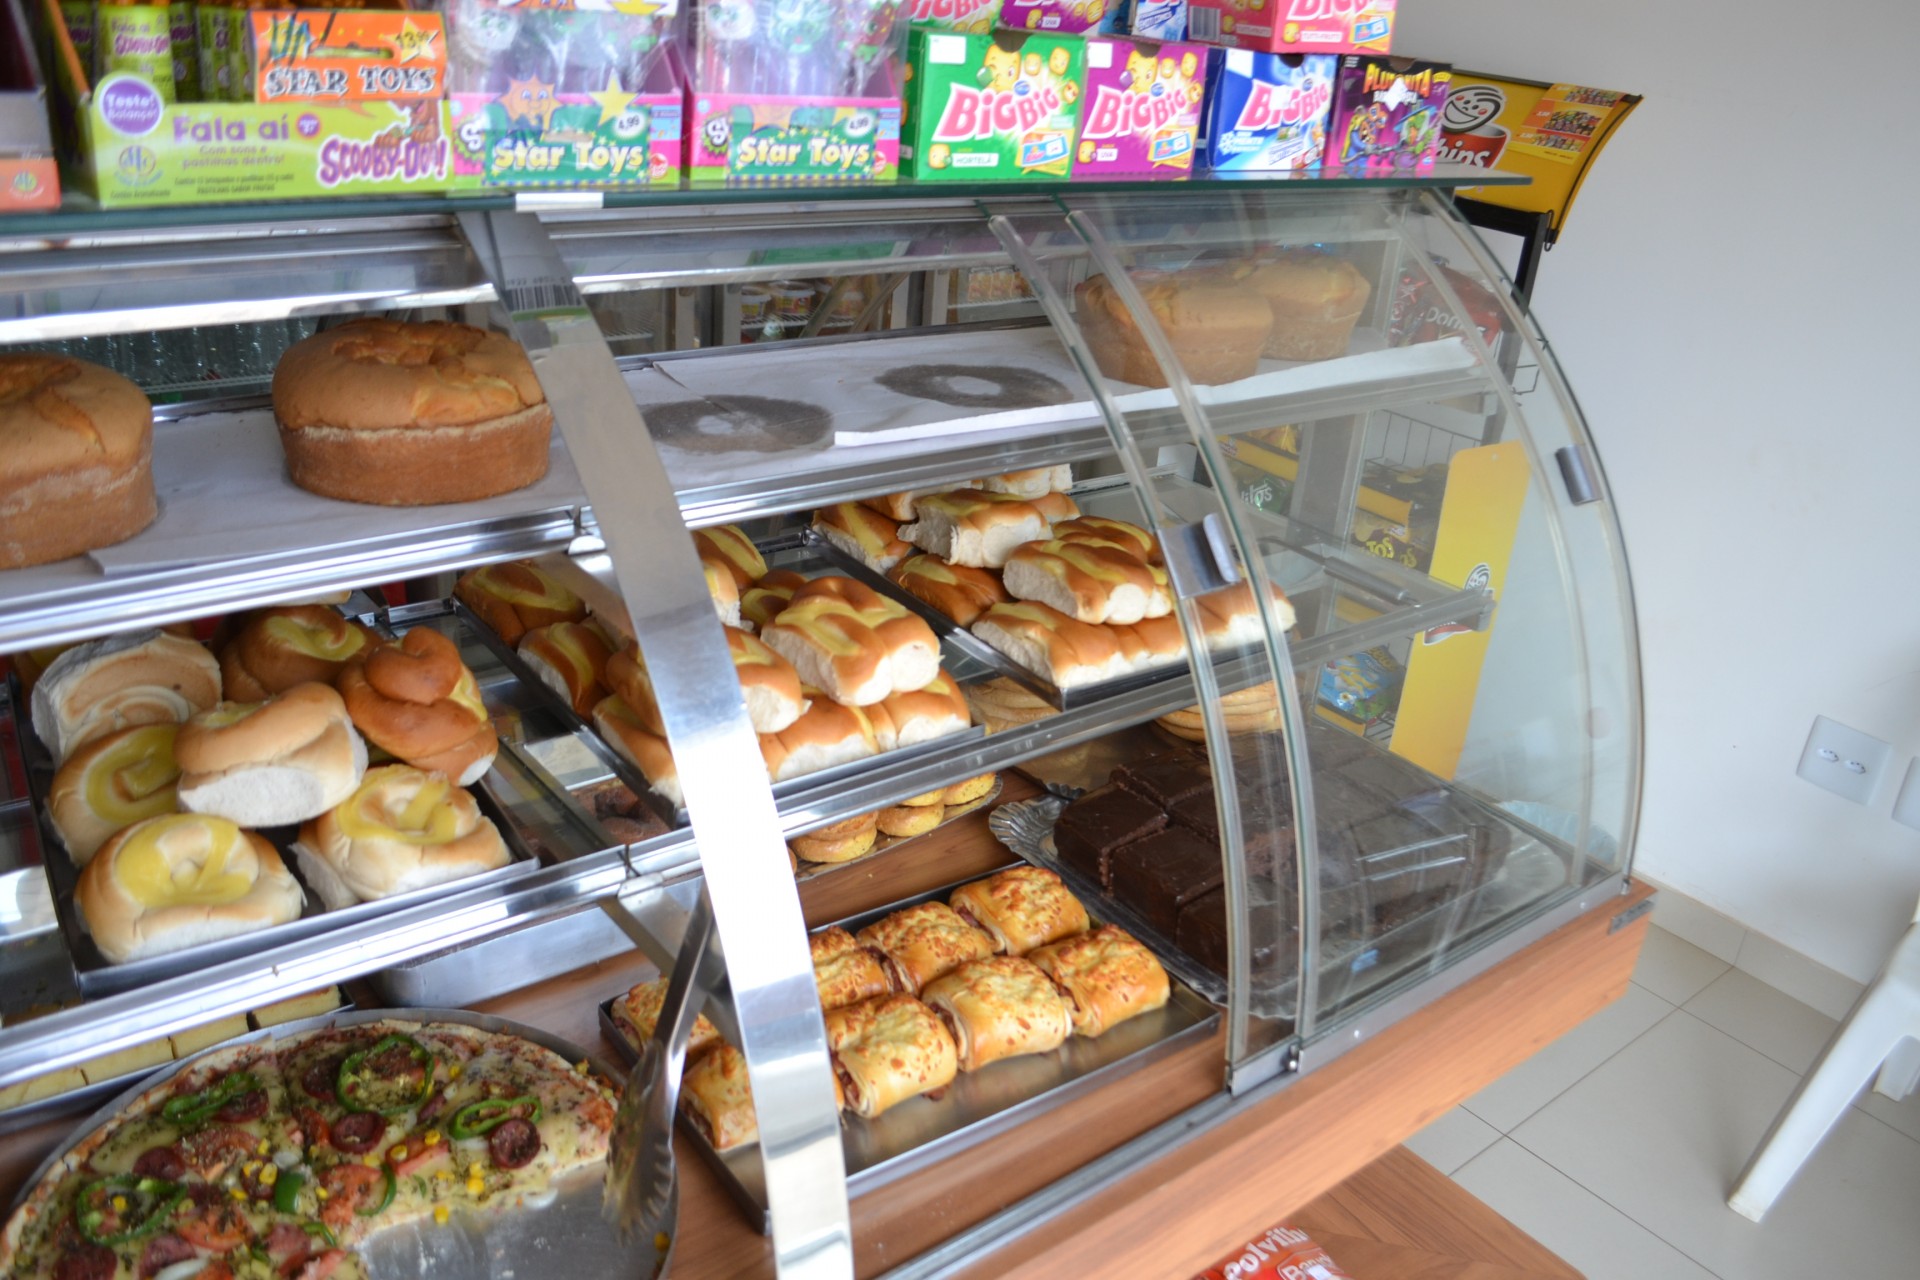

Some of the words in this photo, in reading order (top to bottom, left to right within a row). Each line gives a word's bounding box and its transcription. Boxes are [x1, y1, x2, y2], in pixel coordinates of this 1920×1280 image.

[264, 66, 348, 98] STAR
[358, 66, 436, 95] TOYS
[1363, 63, 1432, 97] PLUTNITA
[174, 116, 246, 143] Fala
[258, 114, 289, 140] aí
[493, 140, 565, 172] Star
[573, 141, 644, 177] Toys
[739, 136, 801, 167] Star
[808, 138, 871, 173] Toys
[1223, 1226, 1310, 1280] Polvilh
